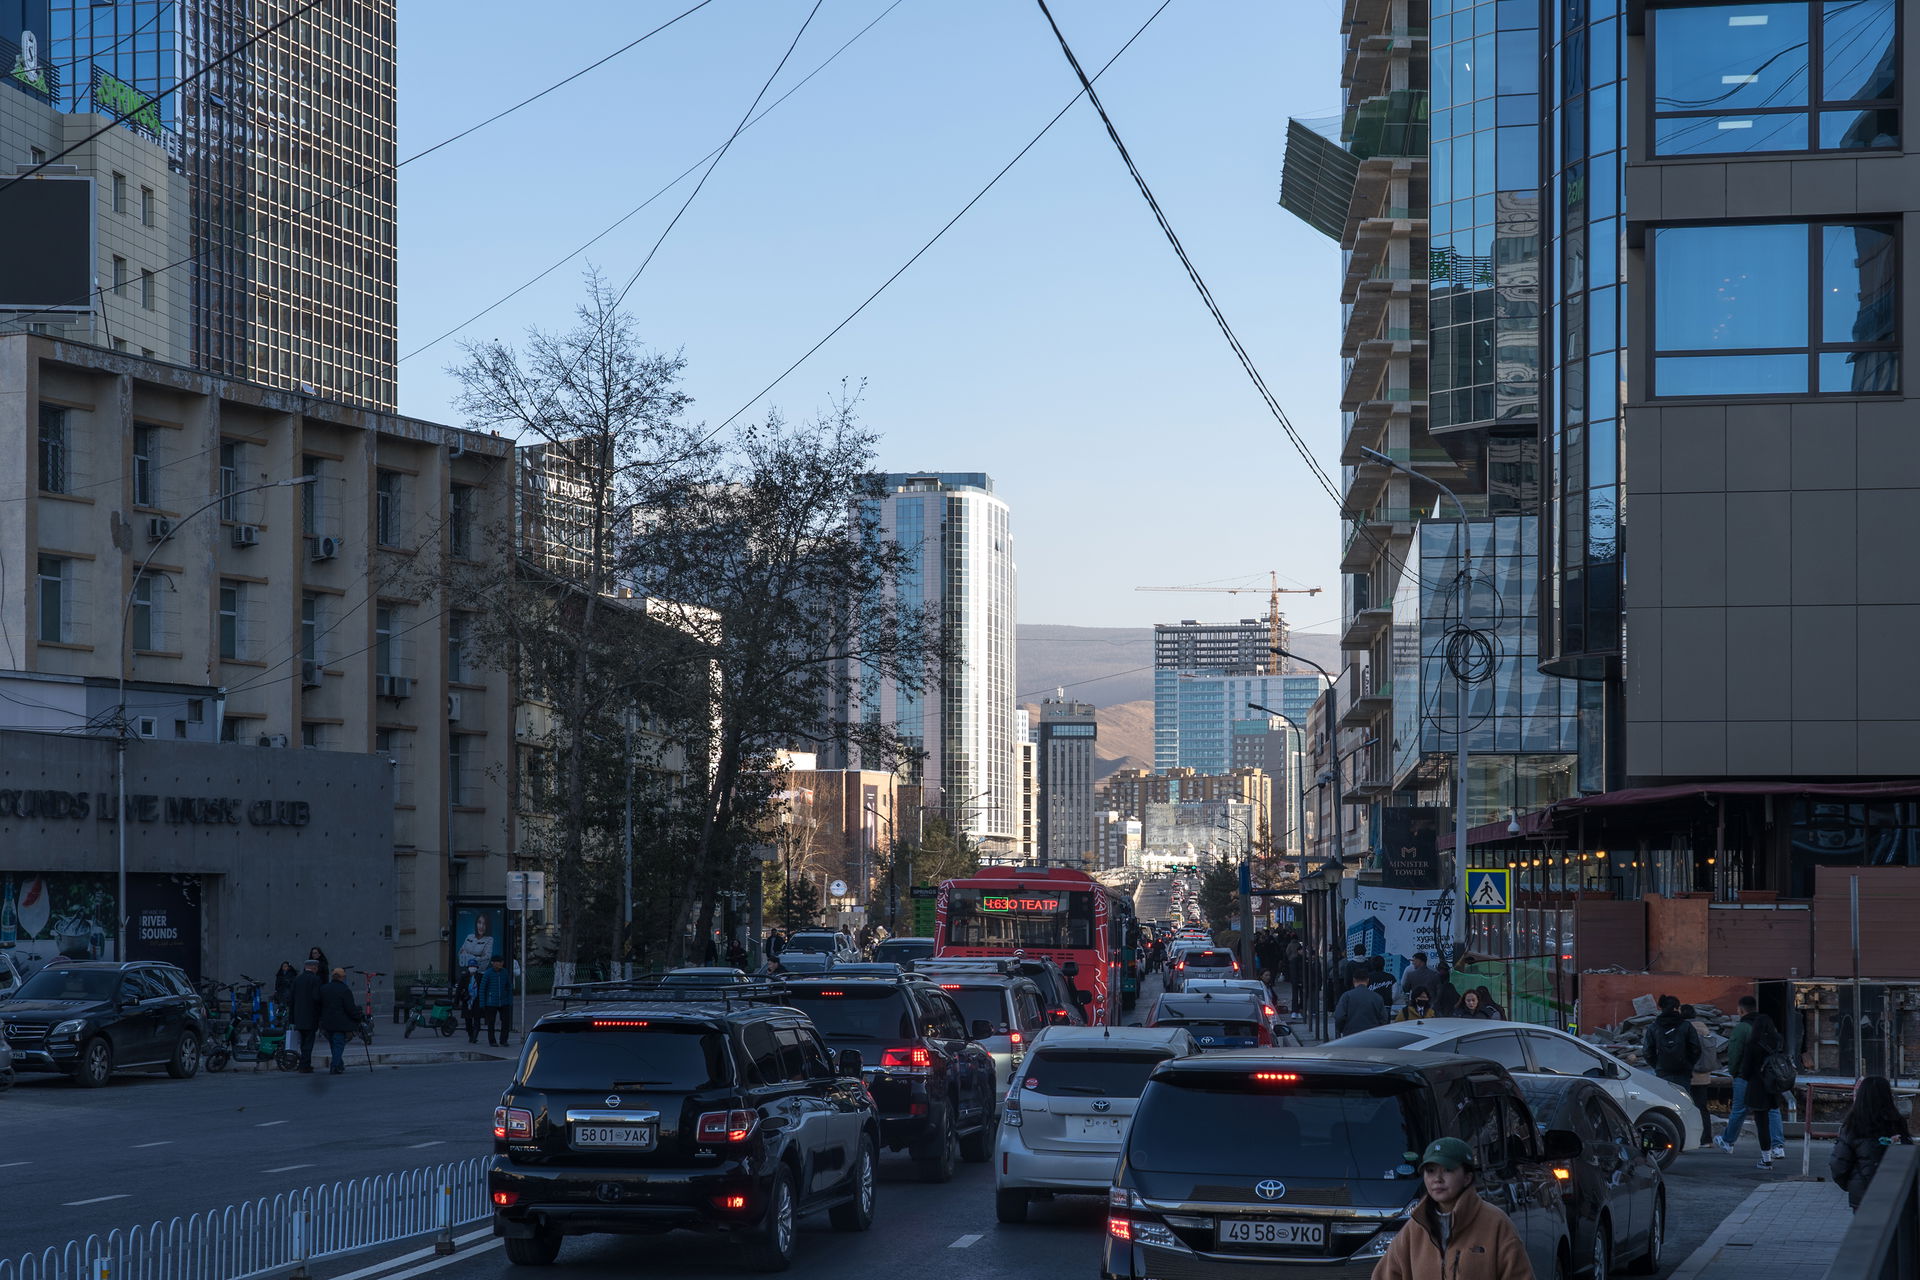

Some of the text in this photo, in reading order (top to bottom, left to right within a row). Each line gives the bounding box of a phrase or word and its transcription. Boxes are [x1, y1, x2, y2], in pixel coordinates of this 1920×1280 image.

[97, 793, 159, 822] LIVE
[165, 796, 243, 825] MUSIC
[249, 800, 310, 826] CLUB
[1390, 860, 1430, 868] MINISTER
[1020, 899, 1058, 910] ТЕАТР
[1364, 900, 1378, 911] ITC
[142, 915, 167, 927] RIVER
[142, 927, 178, 940] SOUNDS
[624, 1130, 647, 1141] УАК
[509, 1144, 543, 1152] PATROL
